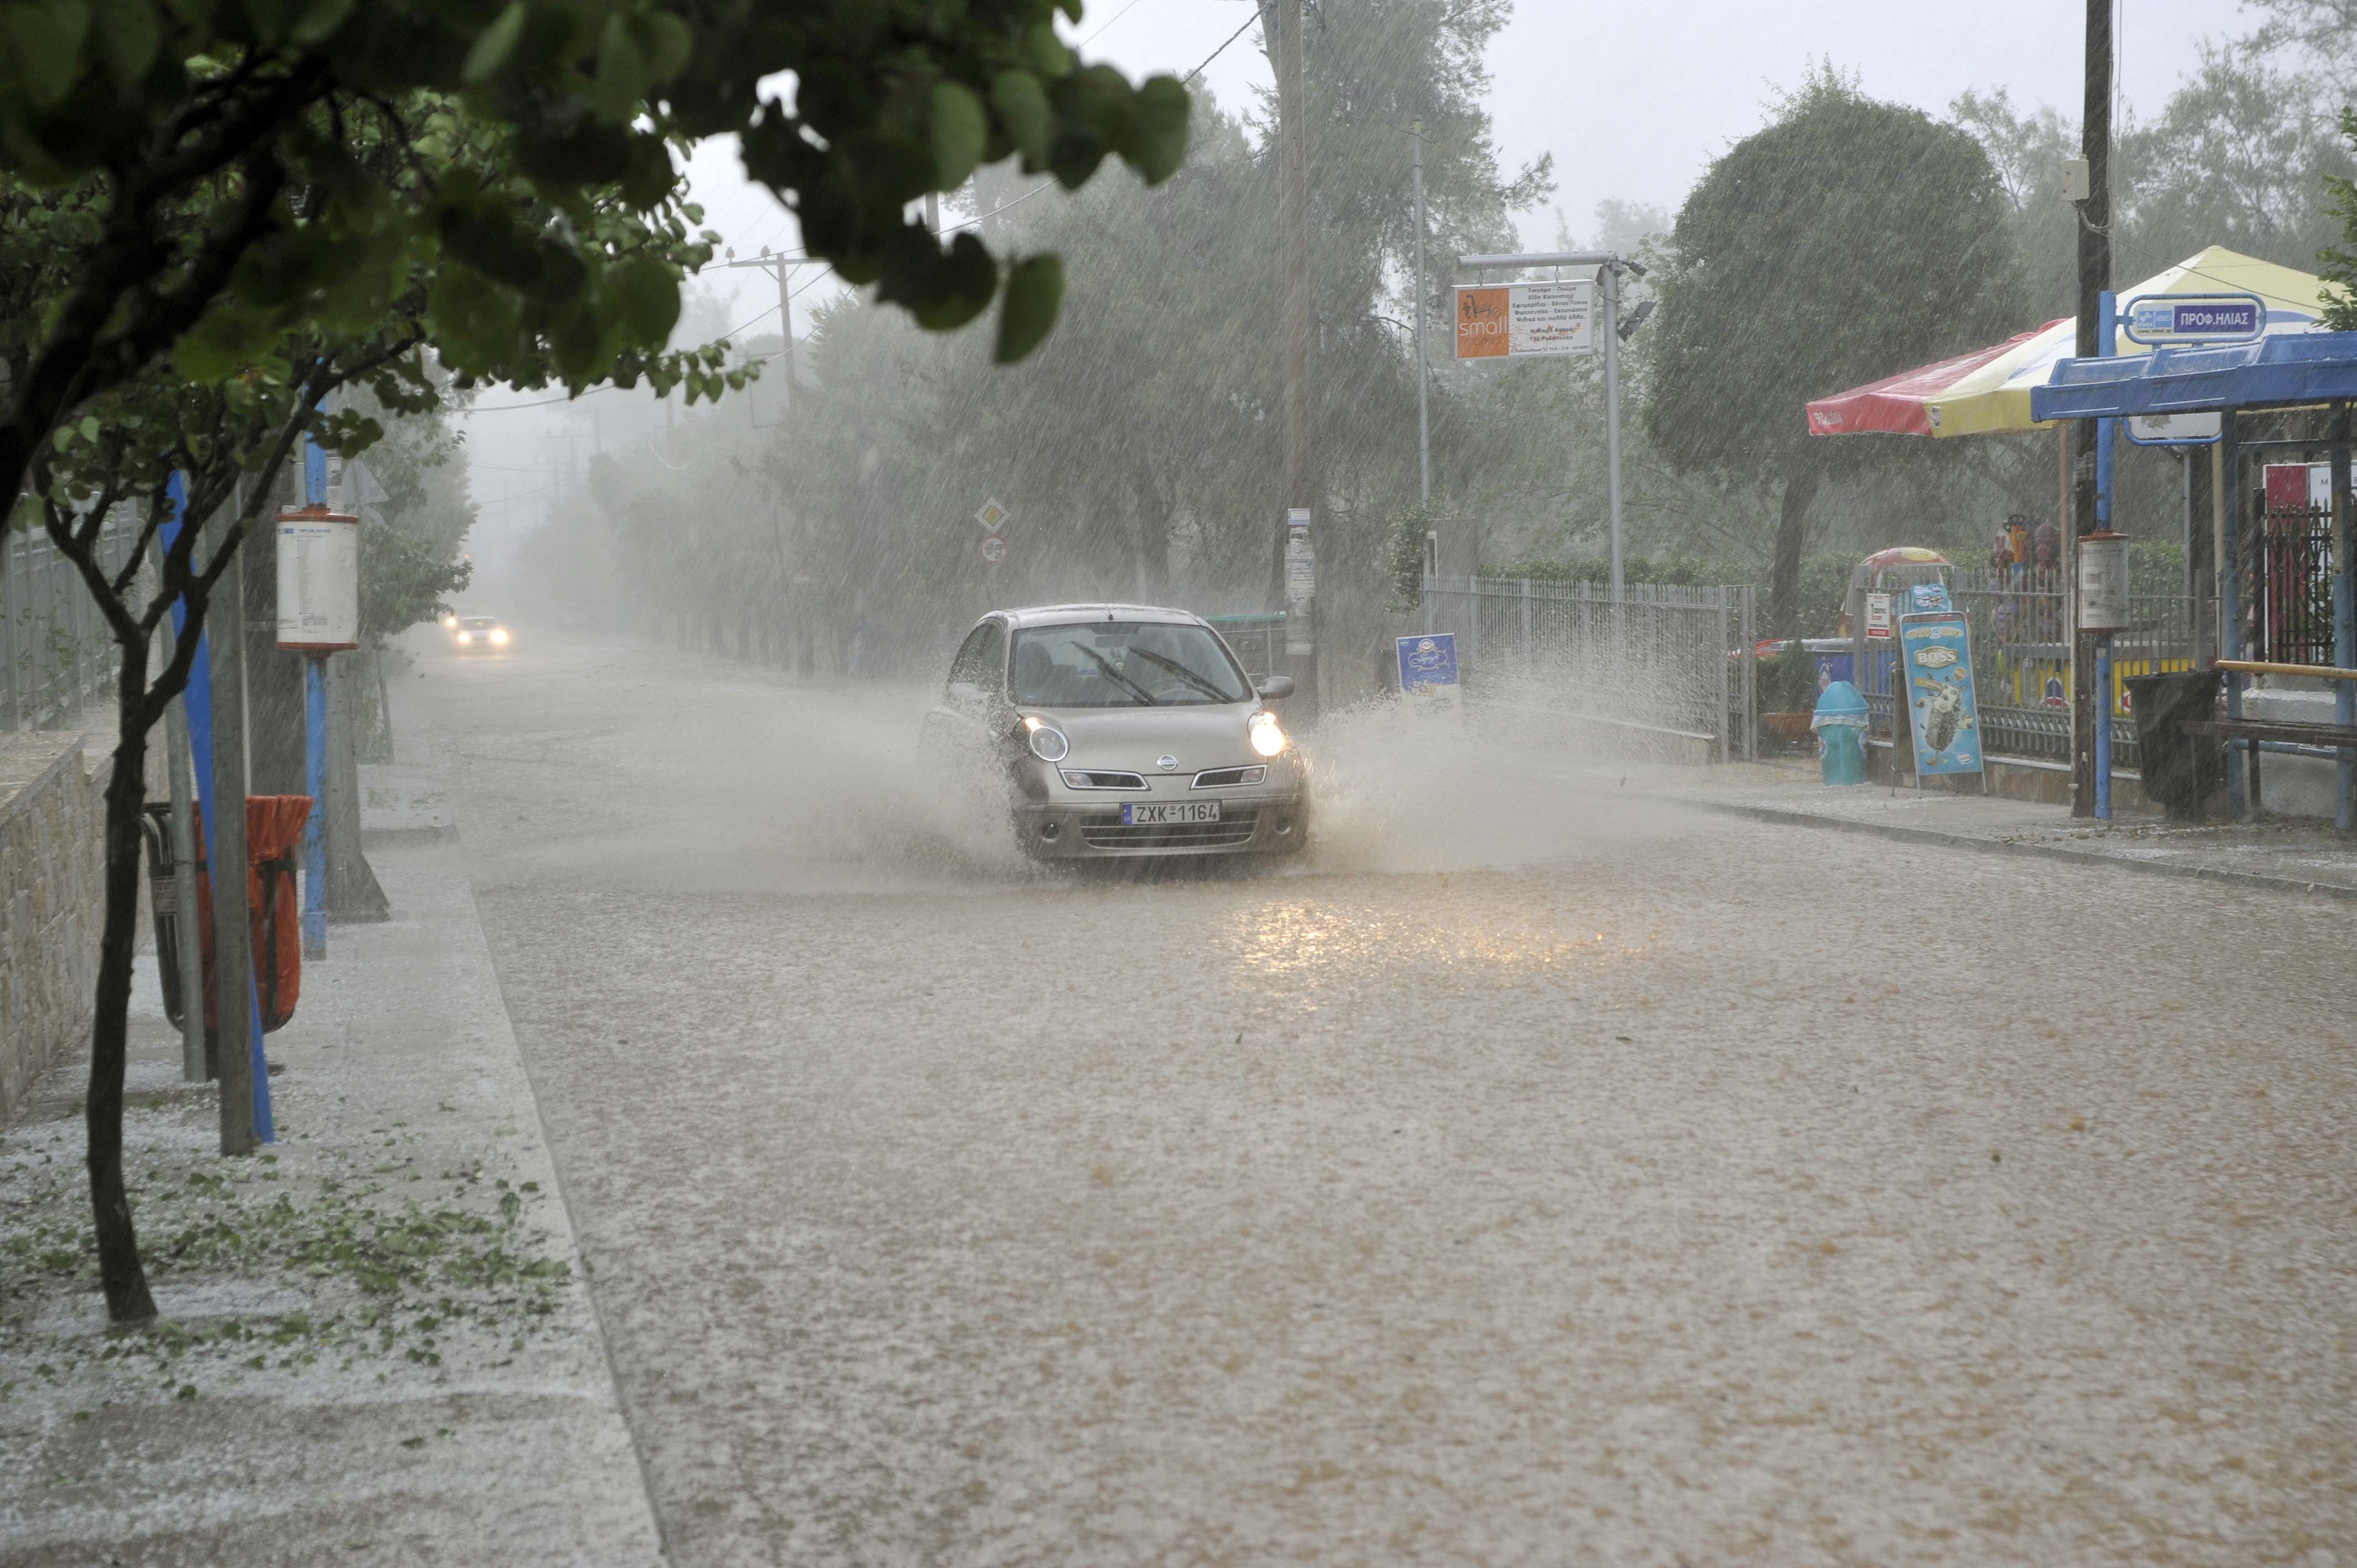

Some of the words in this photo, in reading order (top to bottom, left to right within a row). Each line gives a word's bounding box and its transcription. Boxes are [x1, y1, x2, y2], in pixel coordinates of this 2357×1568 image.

[2180, 312, 2248, 325] ΠΡΟΦ.ΗΛΙΑΣ
[1459, 316, 1507, 337] small
[1917, 651, 1956, 664] BOSS
[1136, 804, 1217, 822] ZXK-1164
